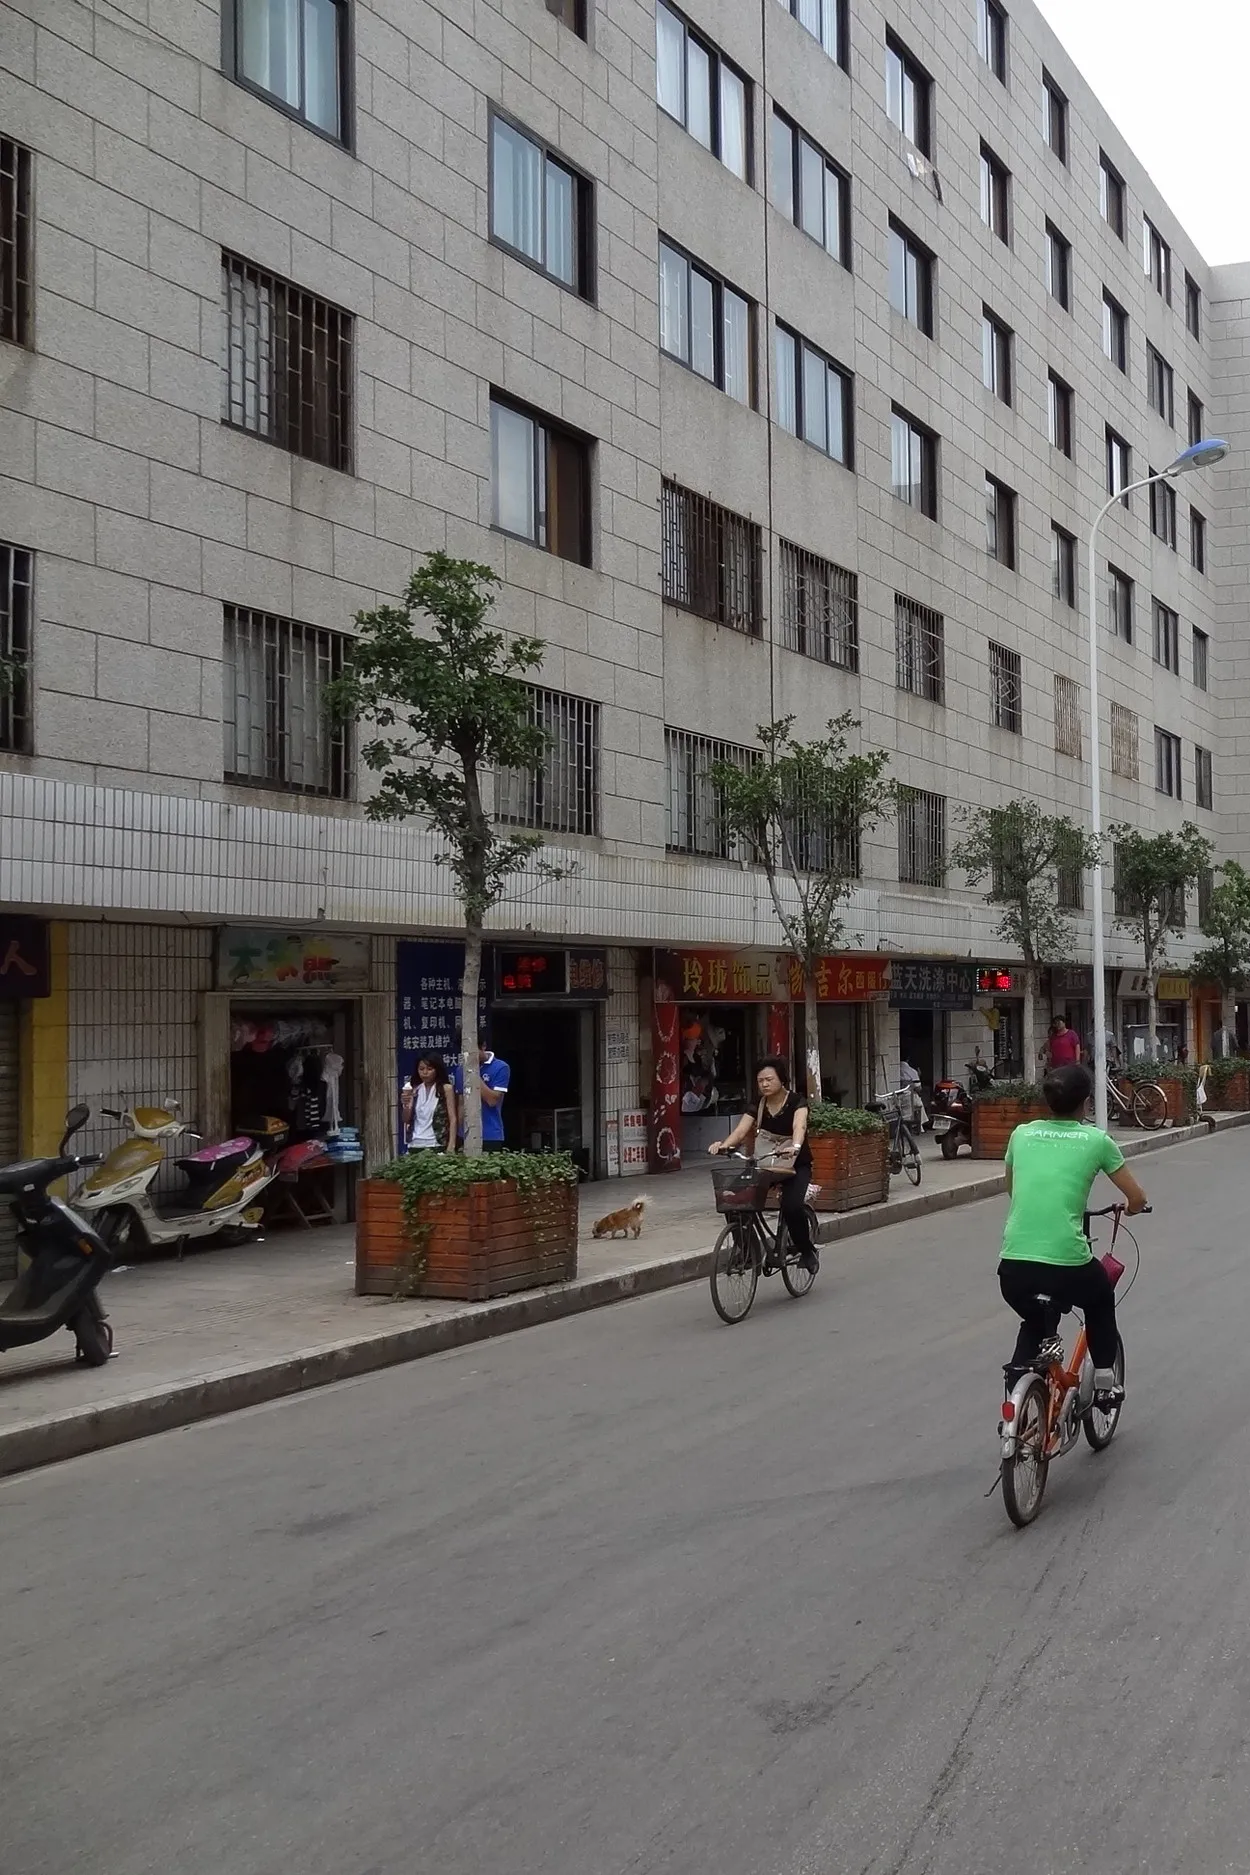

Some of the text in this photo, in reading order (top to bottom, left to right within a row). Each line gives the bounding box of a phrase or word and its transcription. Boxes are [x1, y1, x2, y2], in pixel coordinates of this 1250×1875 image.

[683, 957, 773, 996] 玲珑饰品
[891, 963, 972, 993] 蓝天洗涤中心
[1024, 1129, 1089, 1141] GARNIER
